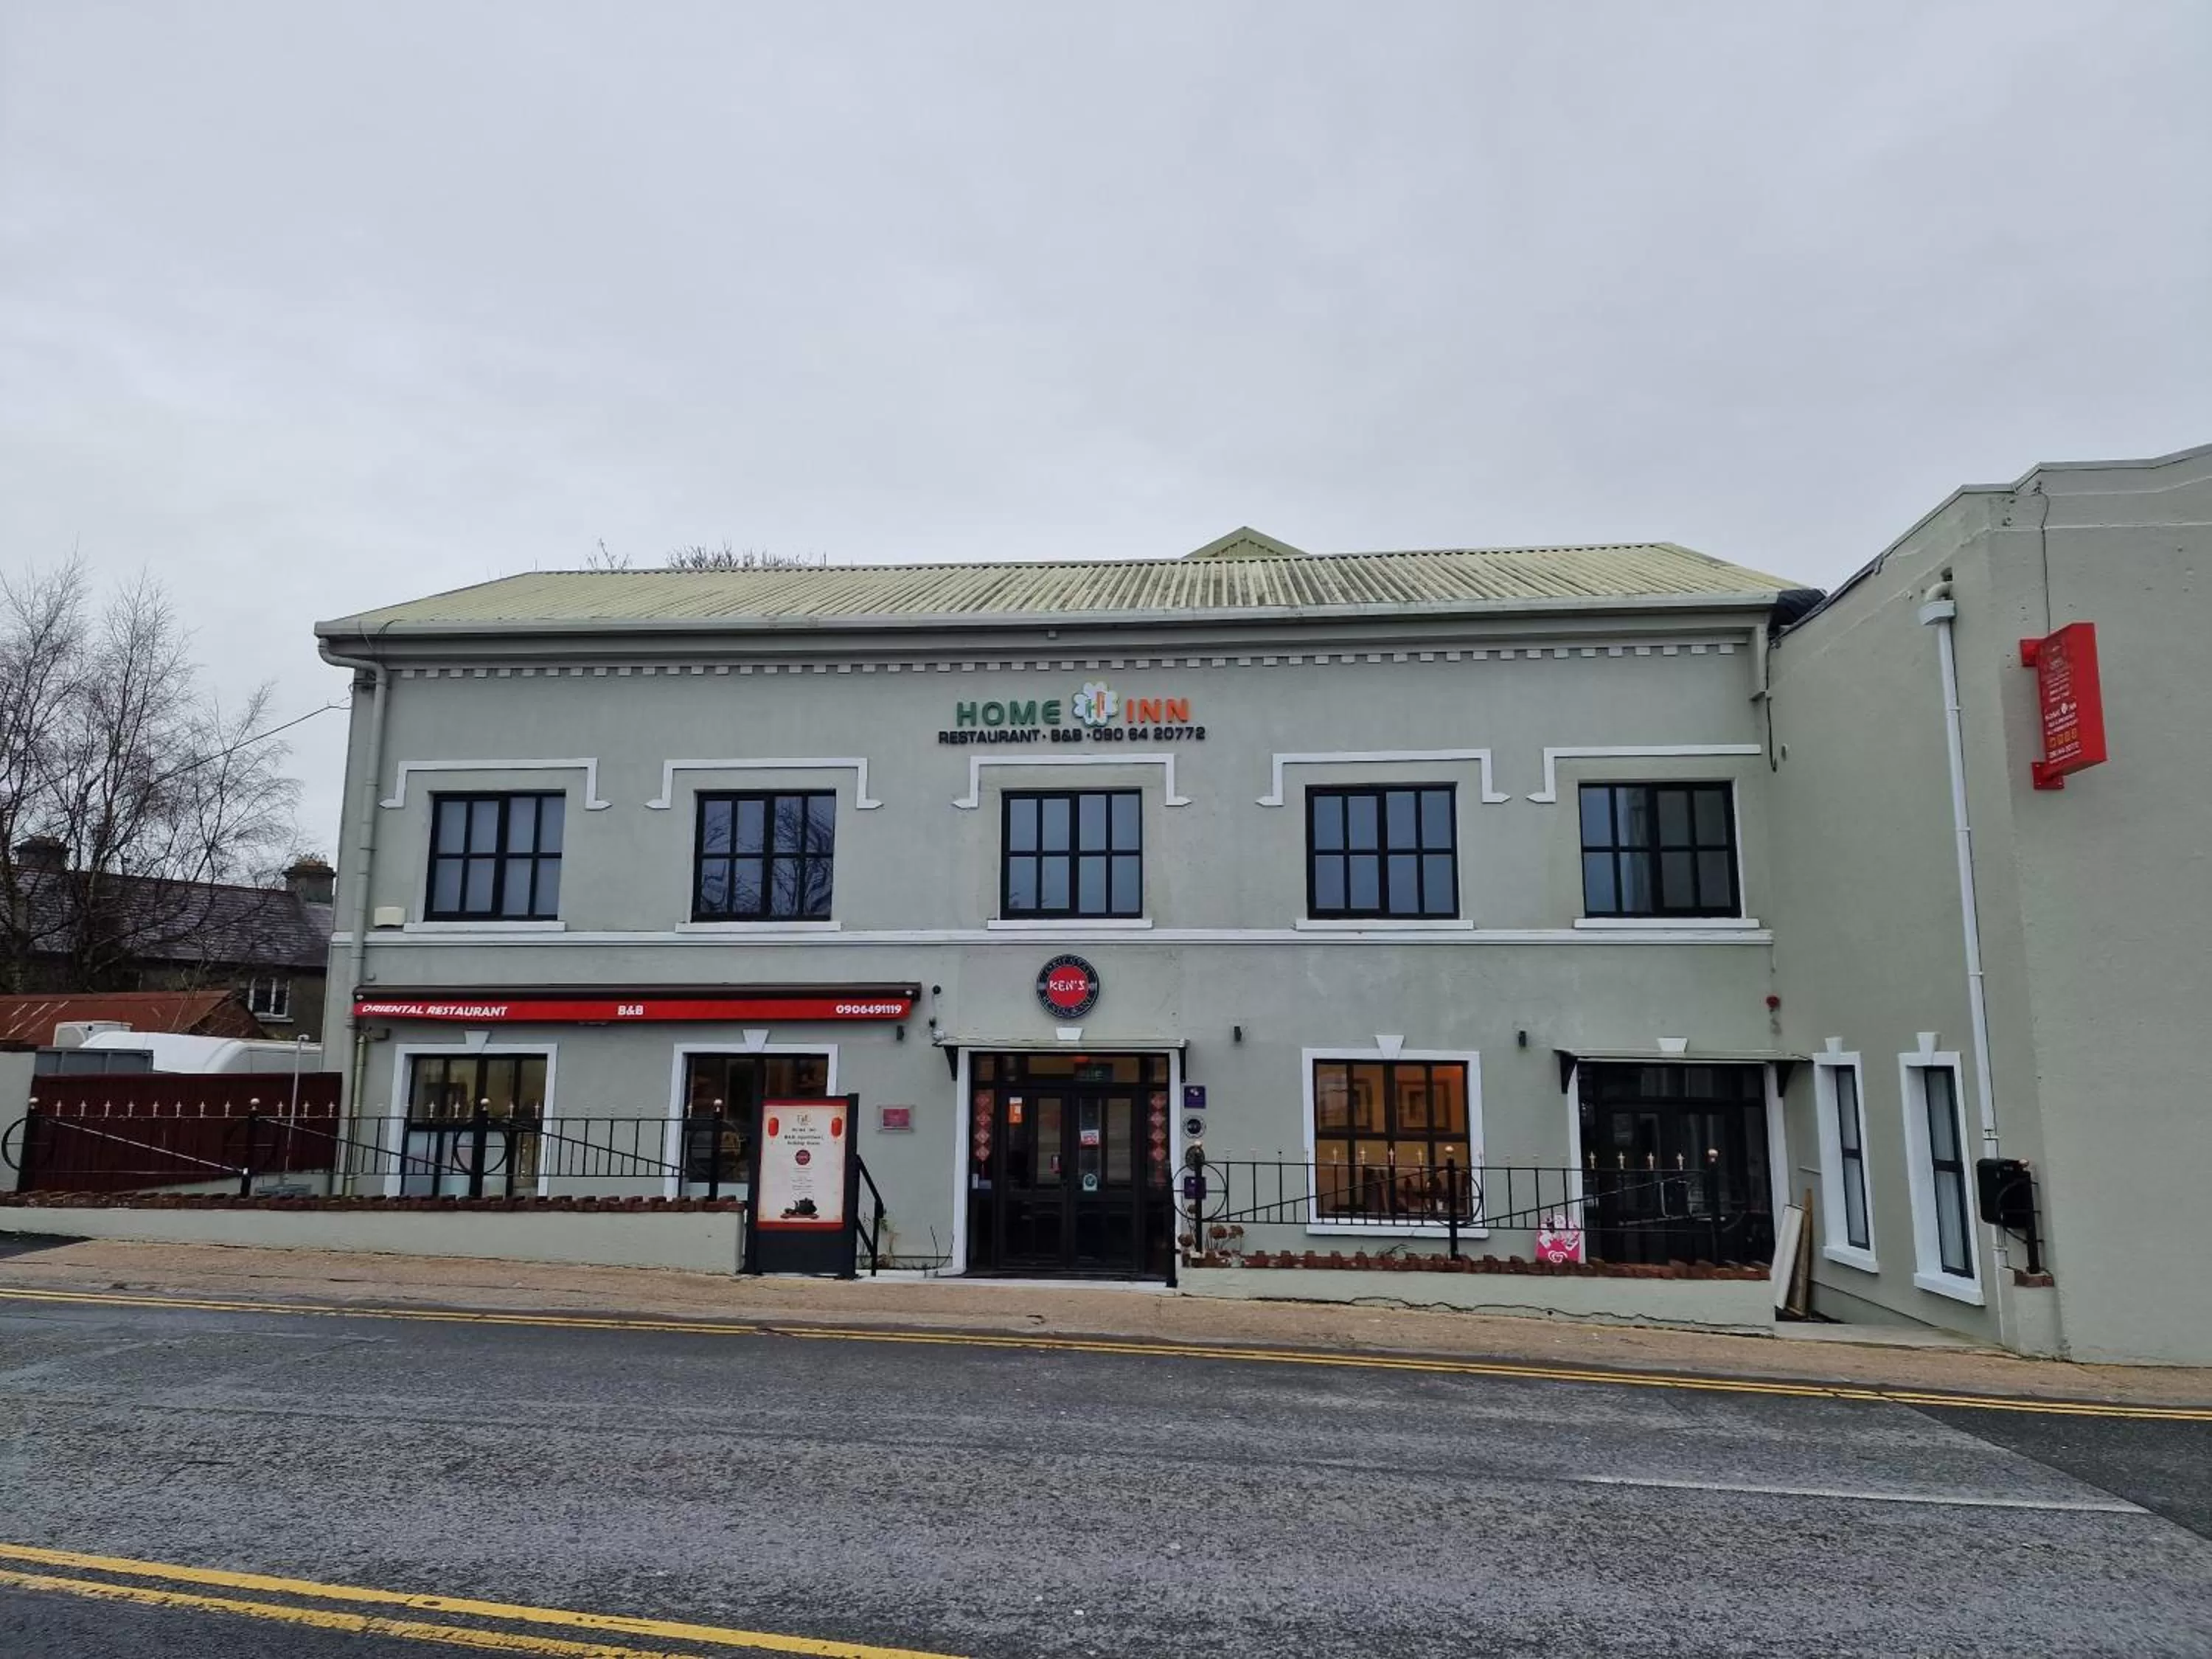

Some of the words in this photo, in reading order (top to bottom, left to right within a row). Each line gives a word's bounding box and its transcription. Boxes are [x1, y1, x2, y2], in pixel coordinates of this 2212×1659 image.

[956, 700, 1062, 726] HOME
[1126, 698, 1190, 724] INN
[1051, 729, 1082, 742] B&B
[1154, 726, 1205, 740] 20772
[1049, 980, 1085, 992] KEN'S
[362, 1004, 424, 1015] ORIENTAL
[426, 1005, 508, 1017] RESTAURANT
[618, 1005, 644, 1015] B&B
